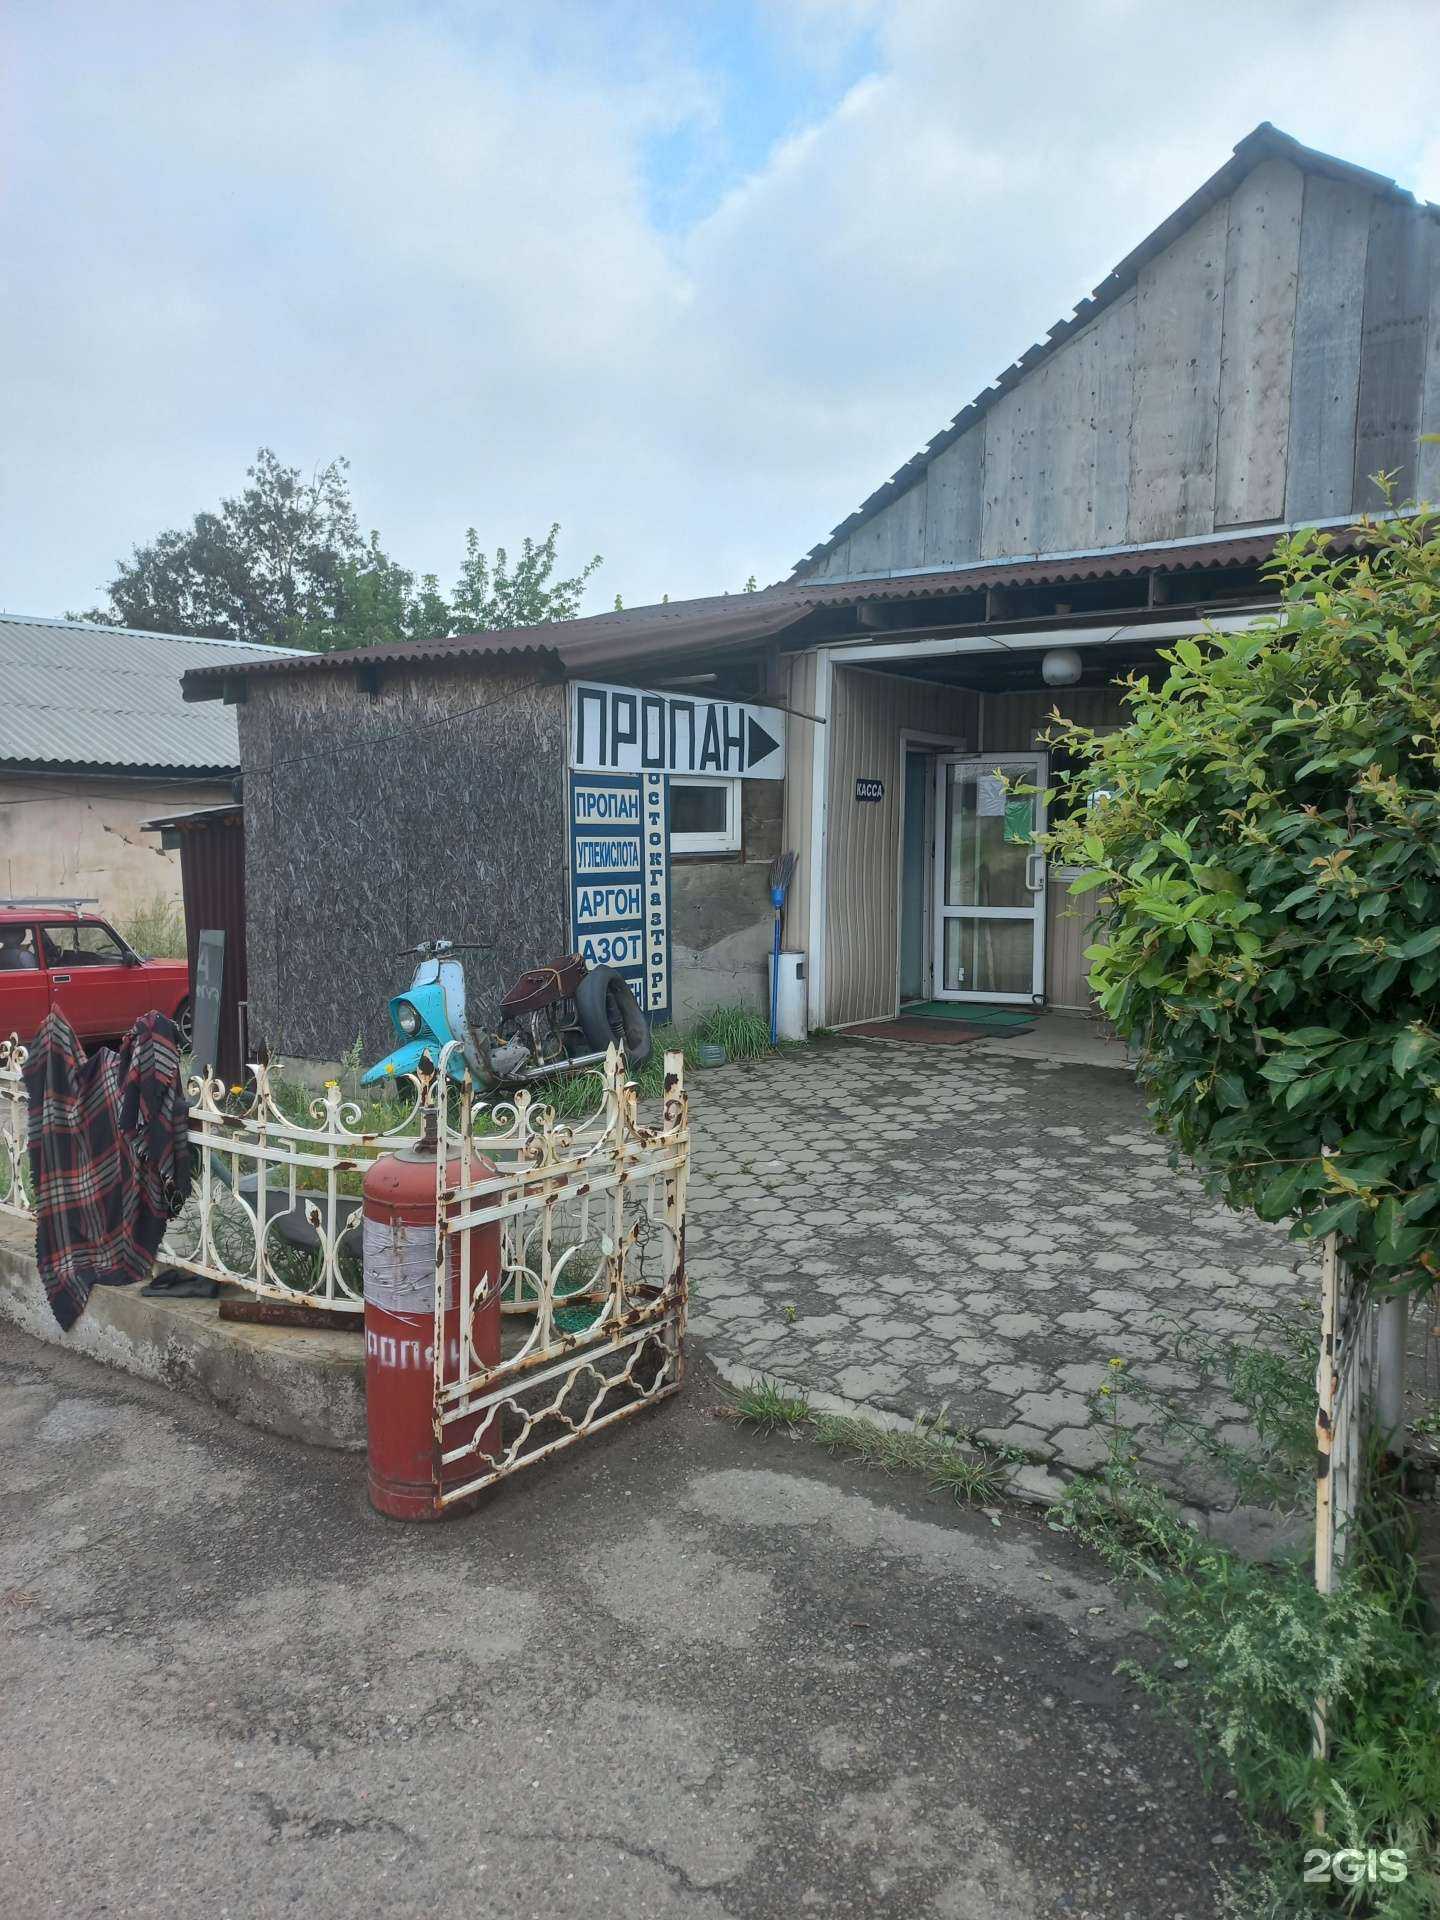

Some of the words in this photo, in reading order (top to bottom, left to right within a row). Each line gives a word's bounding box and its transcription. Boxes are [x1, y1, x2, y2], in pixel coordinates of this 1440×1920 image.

[577, 687, 744, 772] ПРОПАН
[857, 783, 882, 797] КАССА
[576, 793, 638, 818] ПРОПАН
[578, 841, 639, 868] УГЛЕКИСЛОТА
[579, 888, 640, 917] АРГОН
[583, 935, 641, 964] АЗОТ
